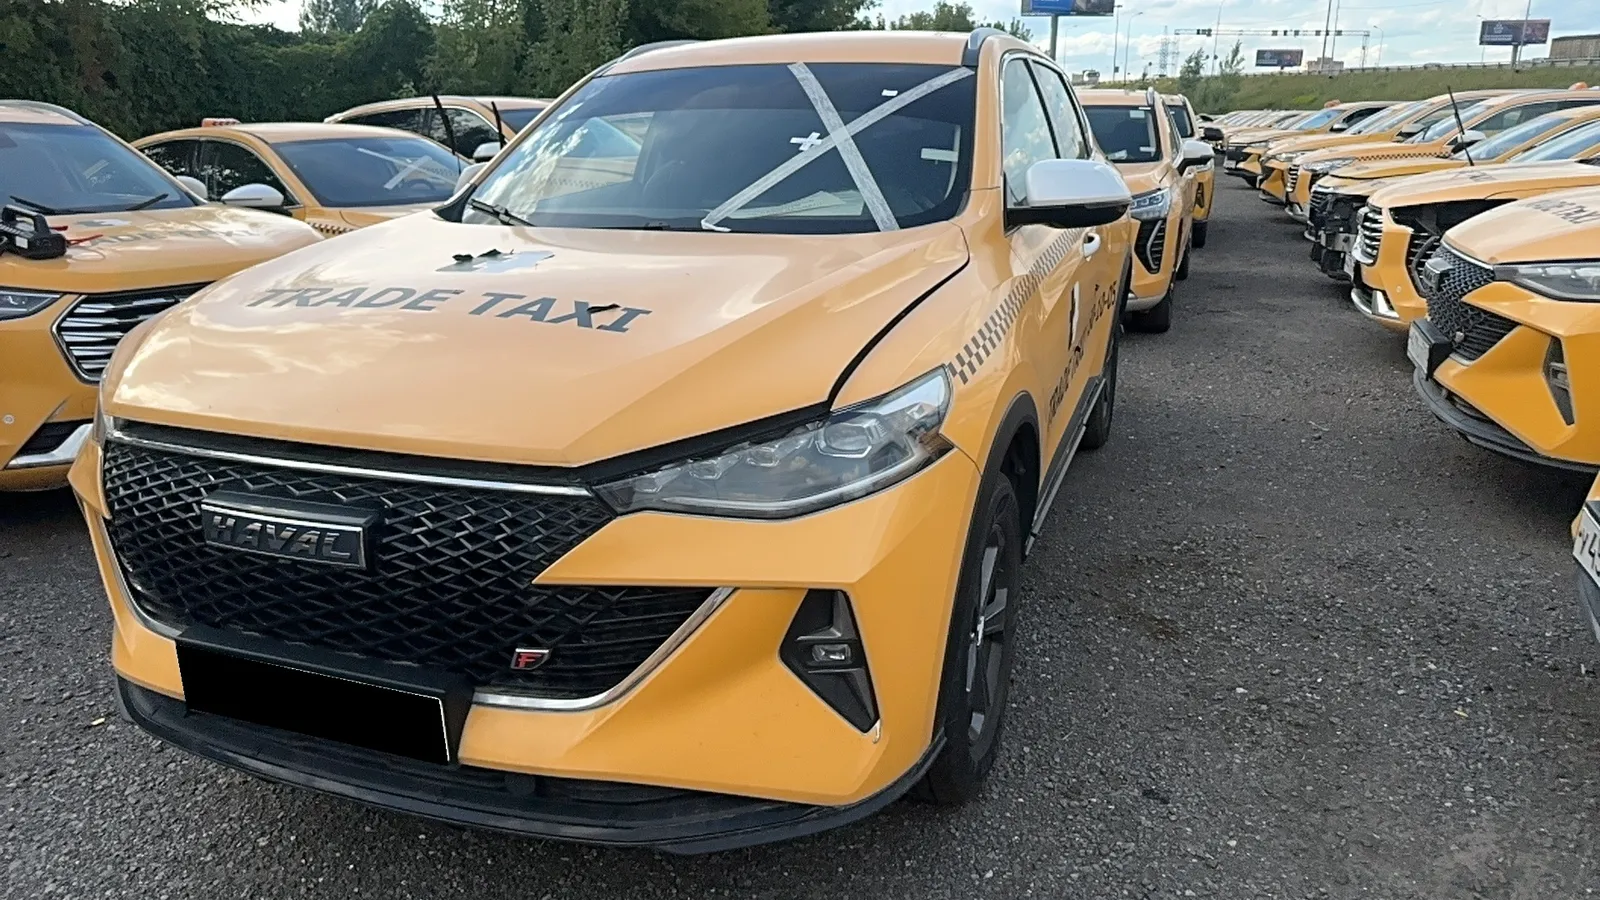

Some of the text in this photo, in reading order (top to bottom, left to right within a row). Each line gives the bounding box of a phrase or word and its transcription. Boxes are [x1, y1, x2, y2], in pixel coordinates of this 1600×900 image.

[245, 287, 652, 333] TRADE TAXI
[210, 515, 351, 560] HAVAL
